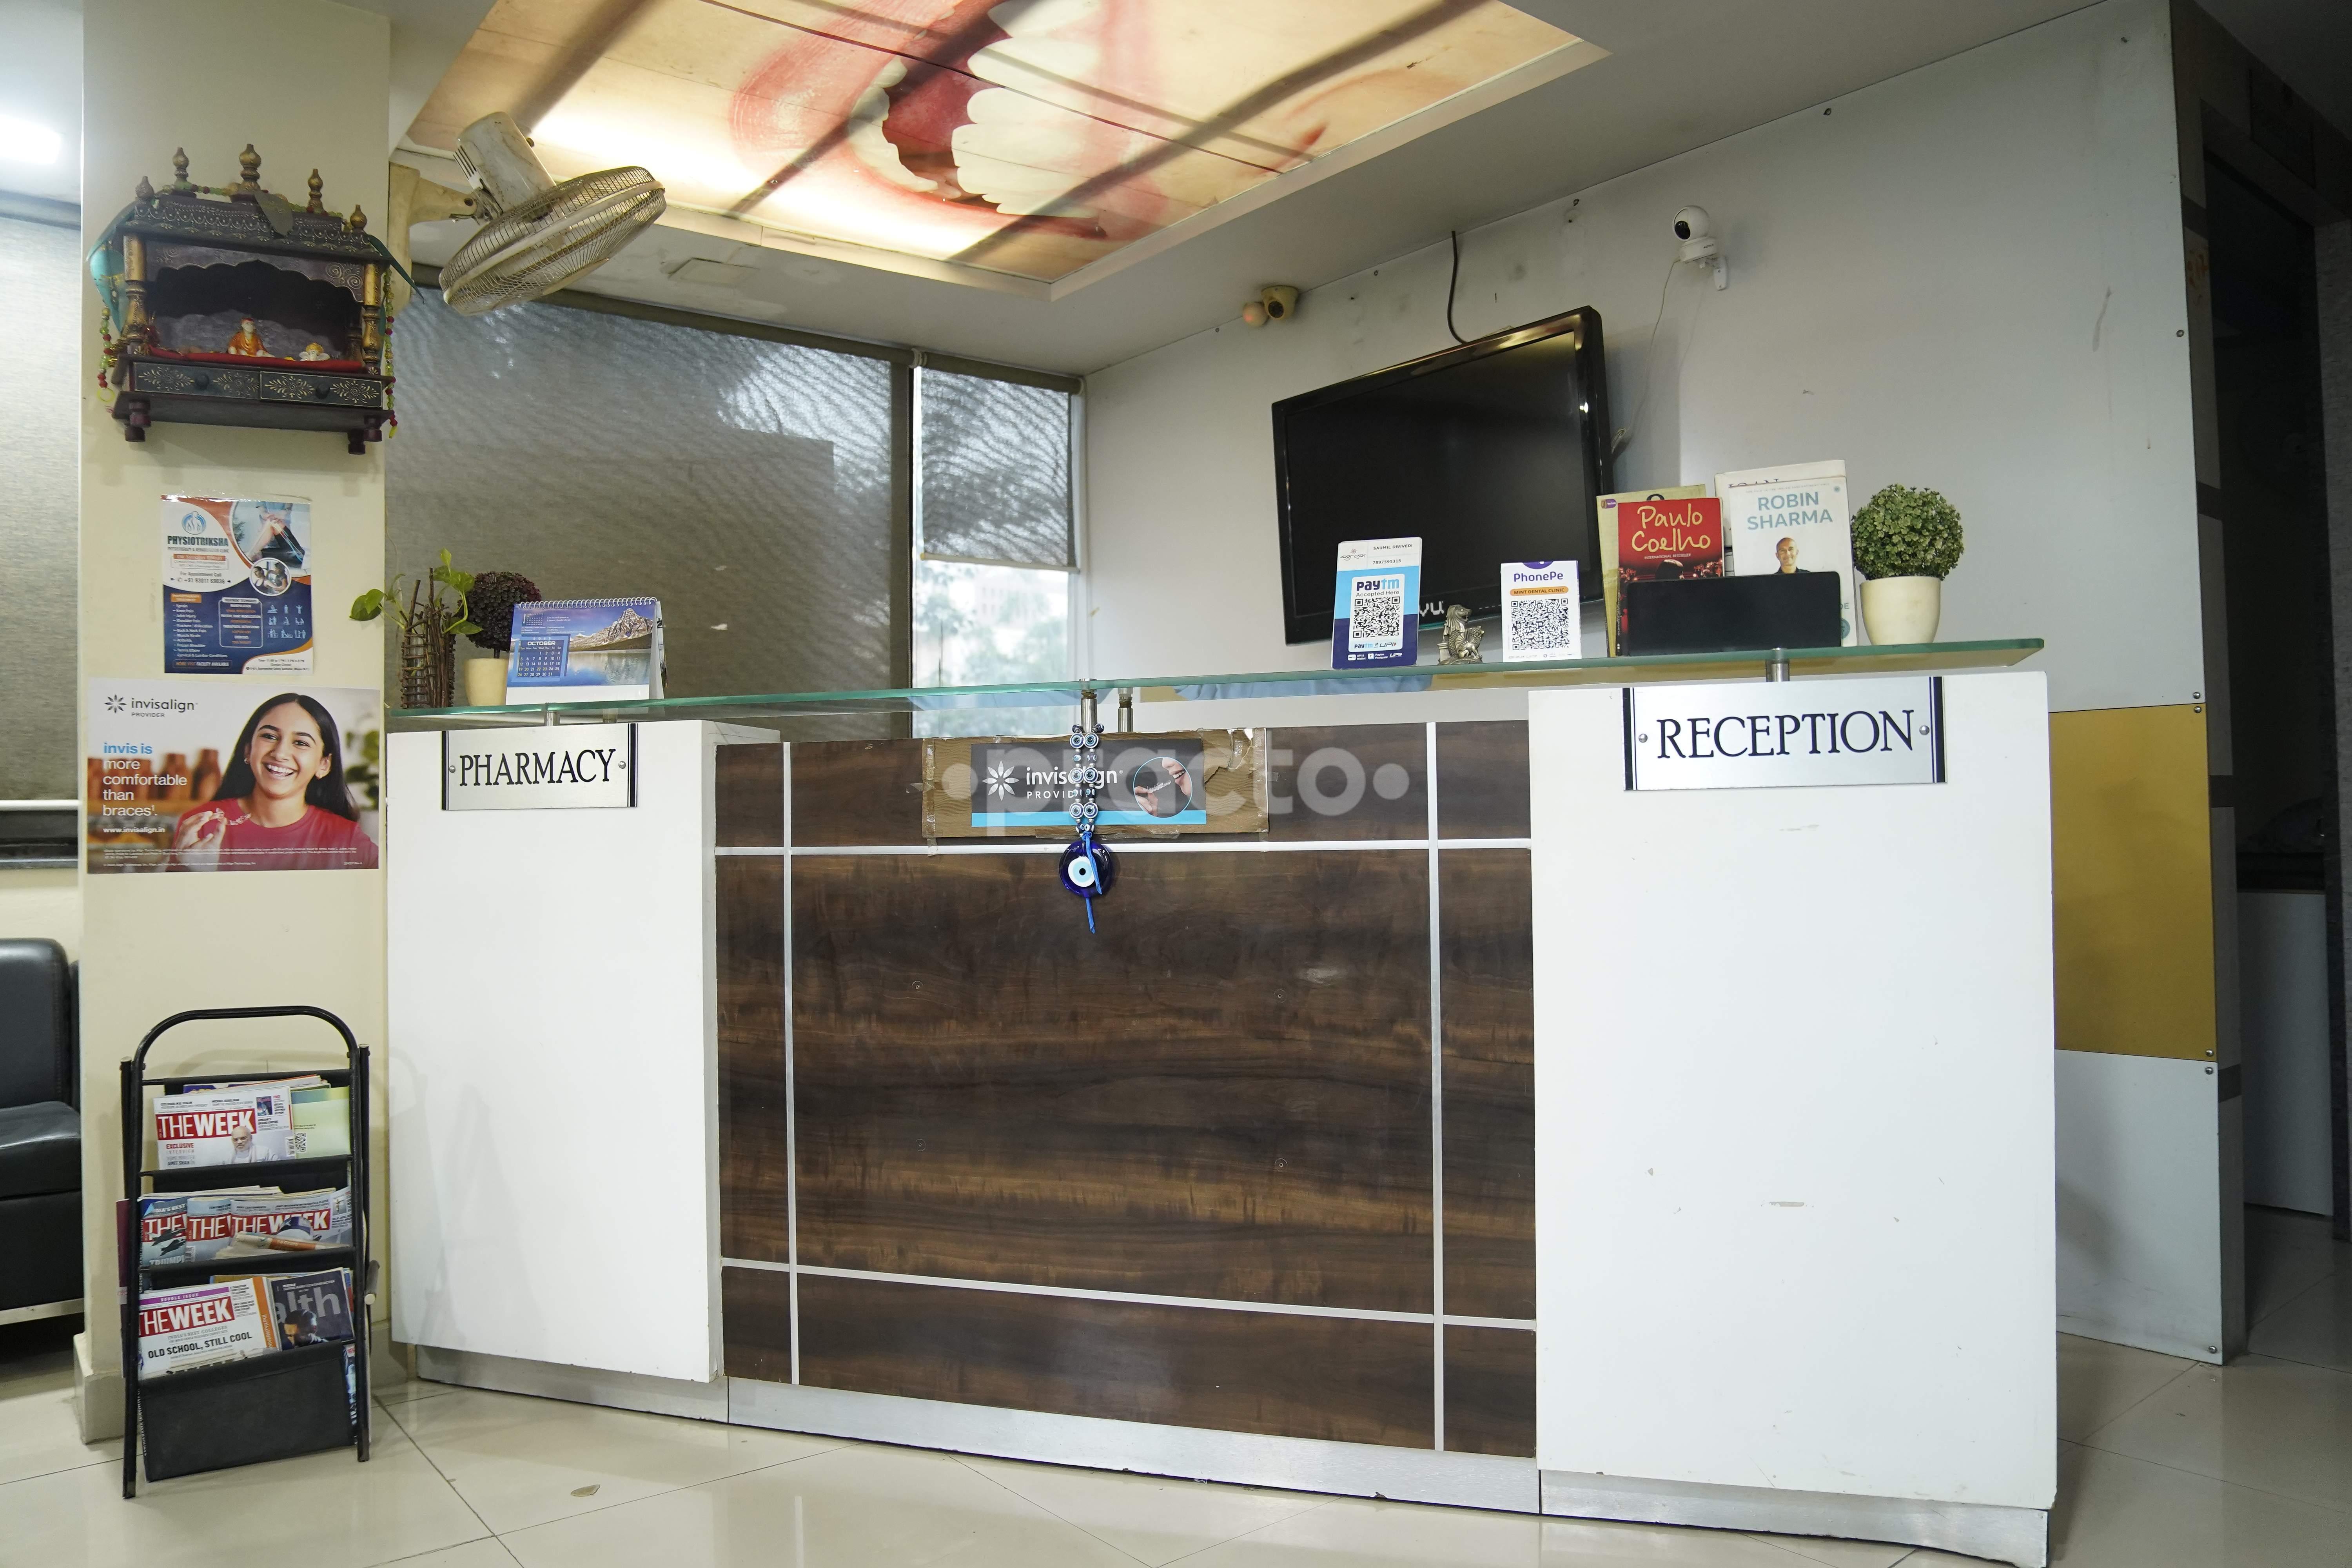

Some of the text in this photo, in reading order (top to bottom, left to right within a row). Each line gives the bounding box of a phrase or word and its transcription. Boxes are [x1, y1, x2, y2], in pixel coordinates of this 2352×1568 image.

[1758, 492, 1819, 511] ROBIN
[1637, 503, 1703, 529] Paulo
[1747, 509, 1833, 530] SHARMA
[1631, 528, 1711, 553] Coelho
[1514, 572, 1563, 582] PhonePe
[131, 698, 194, 713] invisalign
[1656, 710, 1914, 759] RECEPTION
[103, 742, 152, 754] invis is
[103, 760, 141, 769] more
[459, 749, 616, 786] PHARMACY
[103, 774, 188, 786] comfortable
[103, 789, 134, 800] than
[1027, 790, 1089, 799] PROVID
[148, 1349, 165, 1358] OLD
[167, 1343, 203, 1355] SCHOOL,
[205, 1338, 229, 1348] STILL
[229, 1332, 252, 1342] COOL
